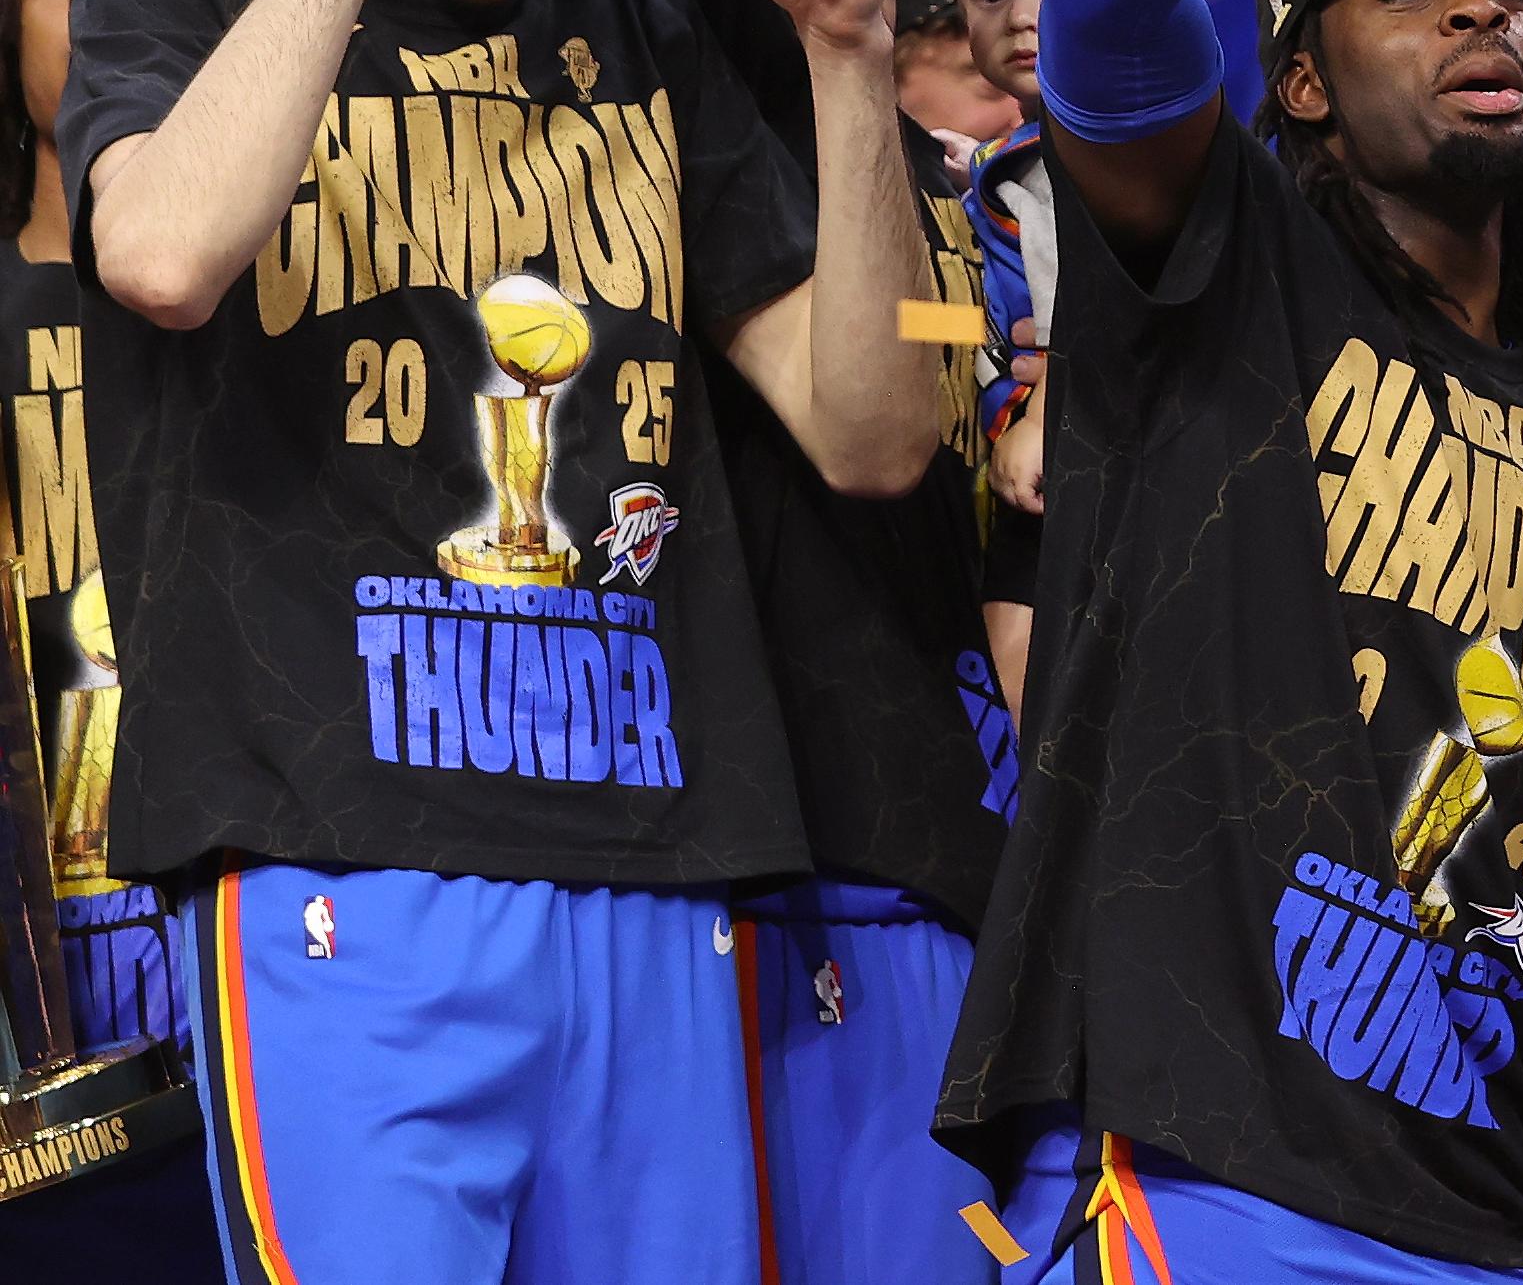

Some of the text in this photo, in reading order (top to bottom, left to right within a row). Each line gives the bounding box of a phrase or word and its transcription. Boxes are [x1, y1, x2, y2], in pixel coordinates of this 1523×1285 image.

[399, 34, 531, 99] NBA
[344, 338, 676, 466] 20 25
[607, 504, 664, 558] OKC
[354, 575, 657, 630] OKLAHOMA CITY
[355, 613, 684, 788] THUNDER
